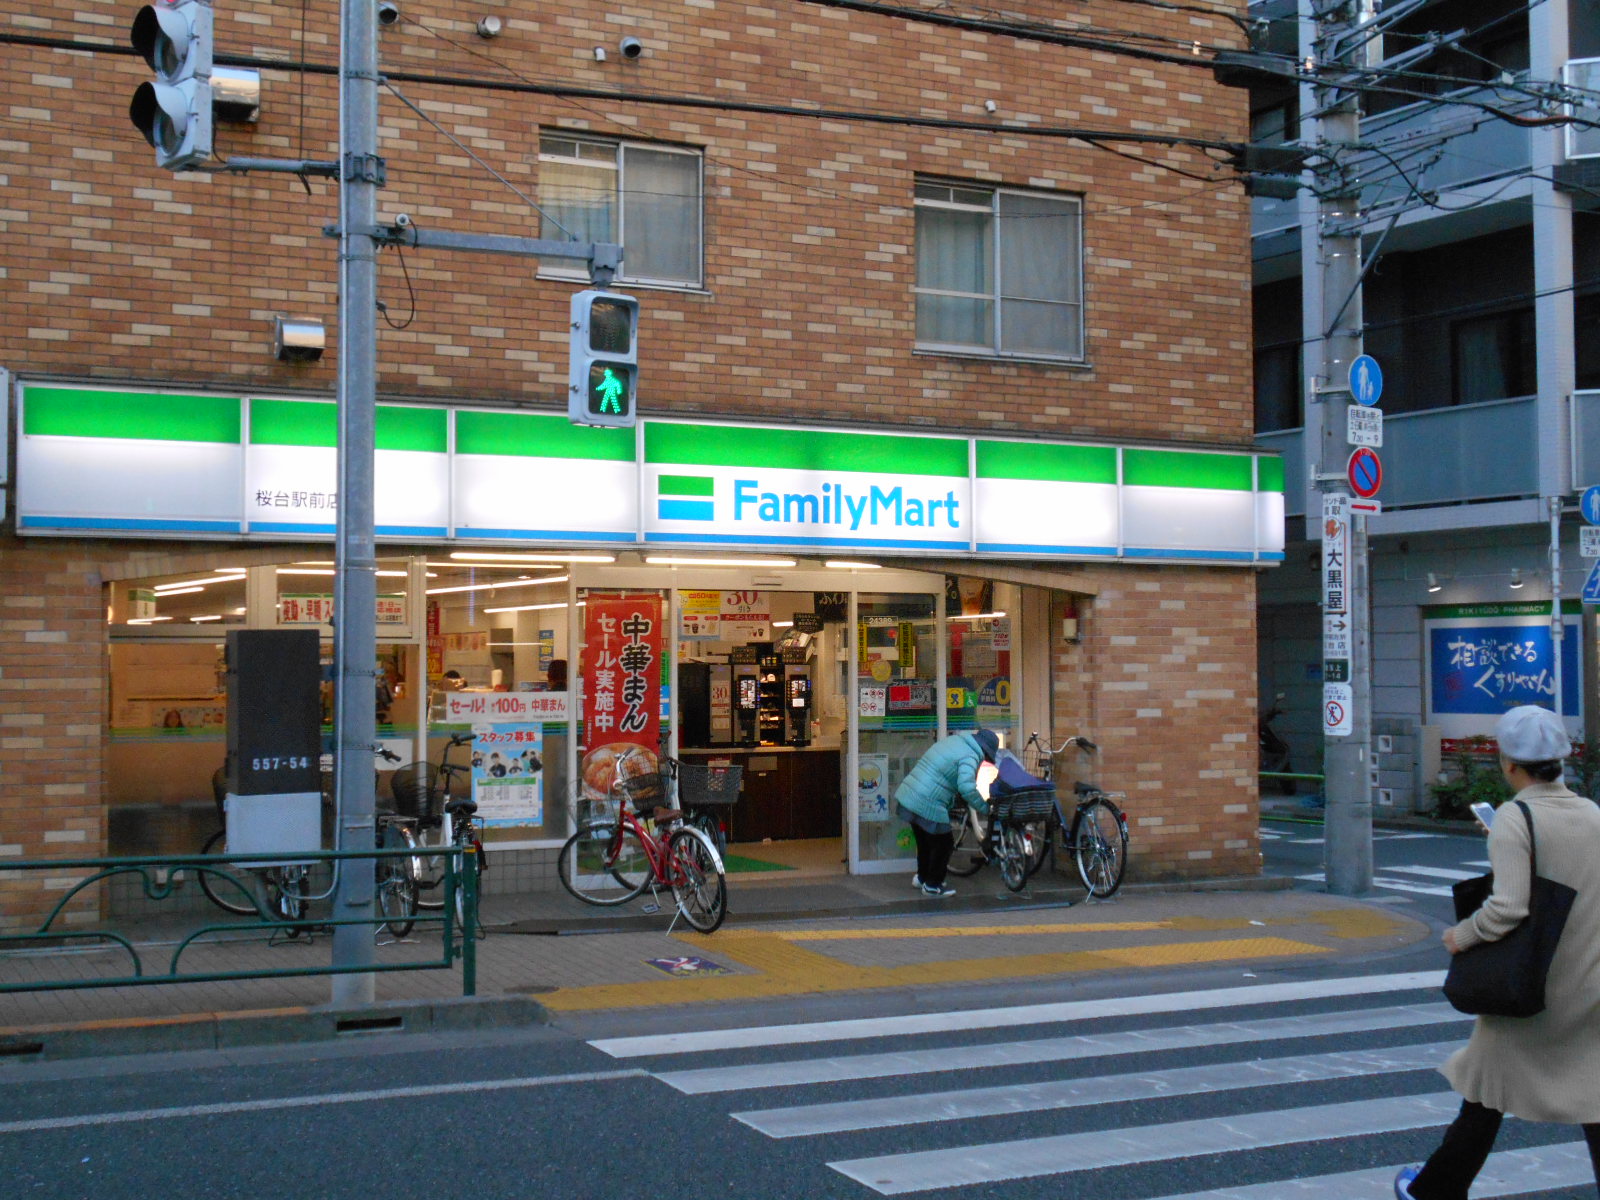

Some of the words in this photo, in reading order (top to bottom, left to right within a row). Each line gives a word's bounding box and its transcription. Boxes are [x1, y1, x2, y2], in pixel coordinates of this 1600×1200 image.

[733, 479, 960, 532] FamilyMart
[1327, 548, 1343, 609] 大黒屋
[1503, 605, 1546, 614] PHARMACY
[594, 612, 617, 733] セール実施中
[619, 613, 653, 733] 中華まん
[531, 699, 566, 712] 中華まん
[479, 731, 537, 743] スタッフ募集
[252, 756, 308, 771] 557-54
